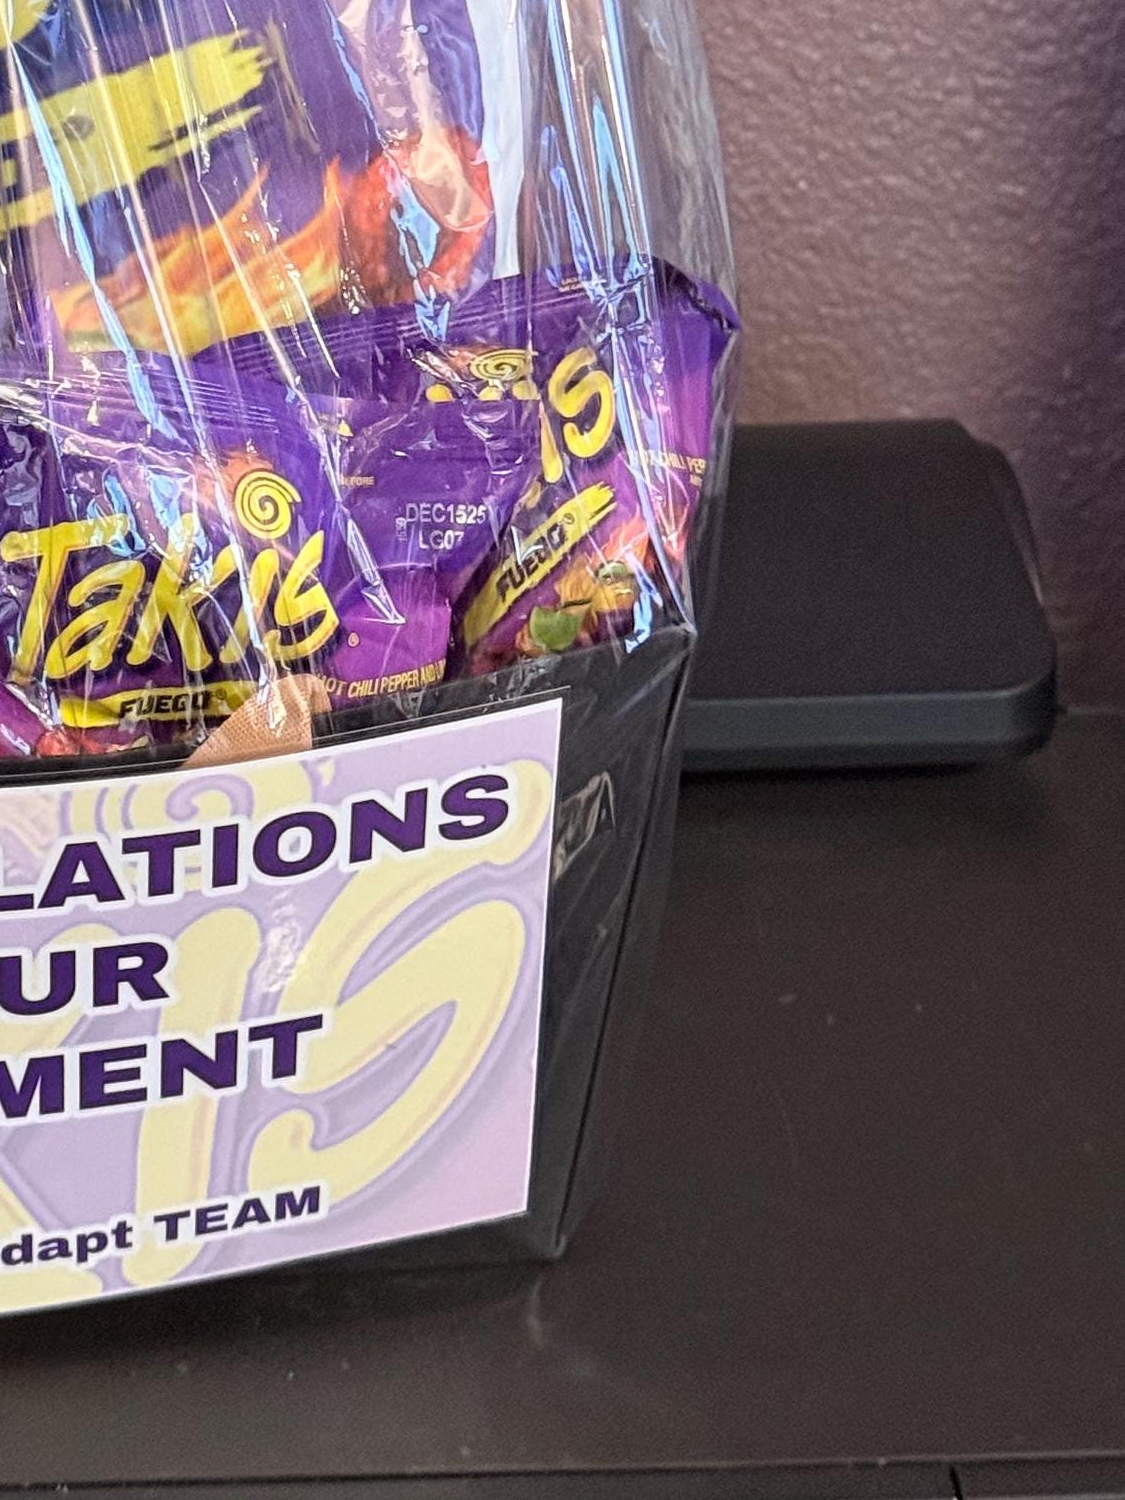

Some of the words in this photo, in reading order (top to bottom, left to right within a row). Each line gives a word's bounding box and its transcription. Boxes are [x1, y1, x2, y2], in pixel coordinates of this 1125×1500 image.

[405, 502, 488, 524] DEC1525
[418, 529, 465, 550] LG07
[347, 678, 379, 699] CHILI
[379, 668, 420, 693] PEPPER
[153, 1185, 321, 1242] TEAM
